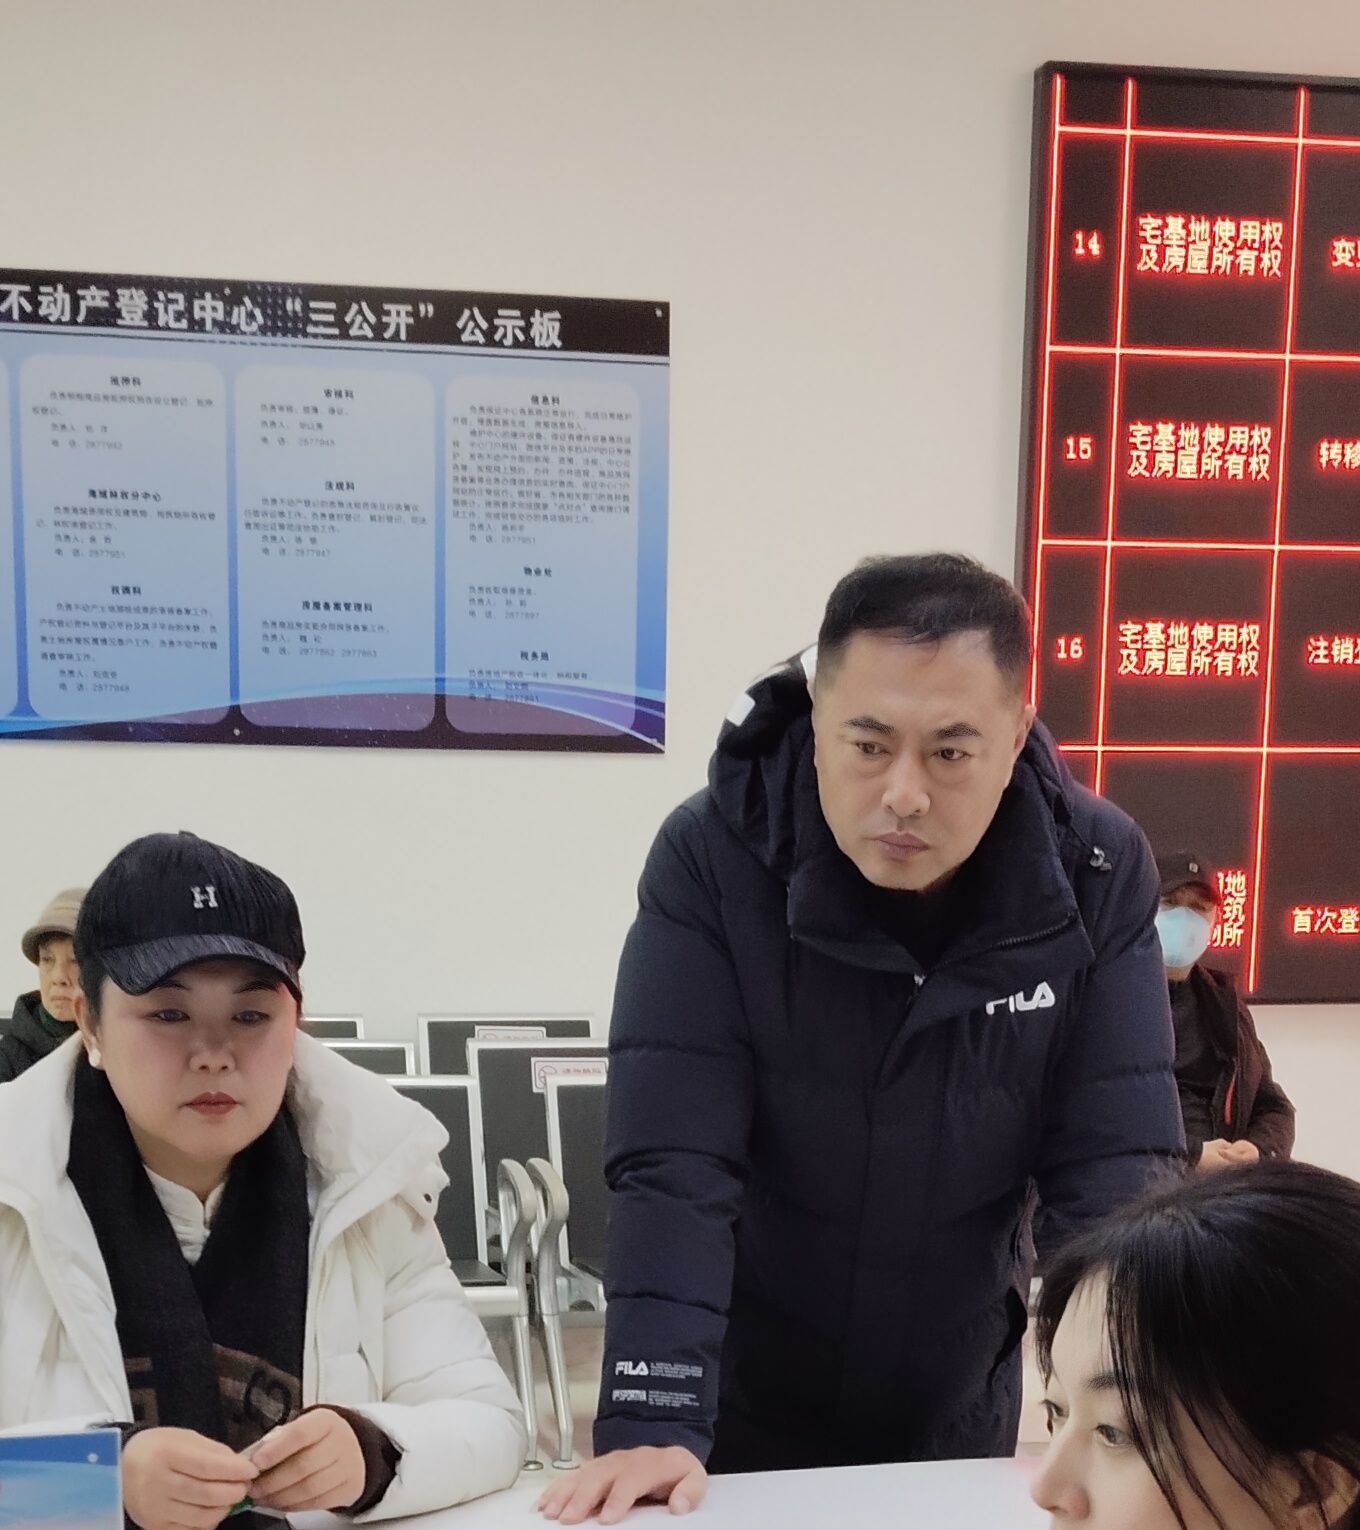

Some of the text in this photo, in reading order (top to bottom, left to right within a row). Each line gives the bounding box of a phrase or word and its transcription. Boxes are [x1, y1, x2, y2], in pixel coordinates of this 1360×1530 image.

[1075, 231, 1101, 257] 14
[1138, 215, 1285, 250] 宅基地使用权
[1136, 243, 1283, 278] 及房屋所有权
[1066, 437, 1092, 460] 15
[1128, 422, 1272, 454] 宅基地使用权
[1127, 451, 1271, 481] 及房屋所有权
[1057, 637, 1083, 660] 16
[1119, 621, 1260, 650] 宅基地使用权
[1118, 648, 1259, 677] 及房屋所有权
[190, 884, 219, 909] H
[985, 980, 1056, 1016] FILA
[615, 1361, 649, 1376] FILA
